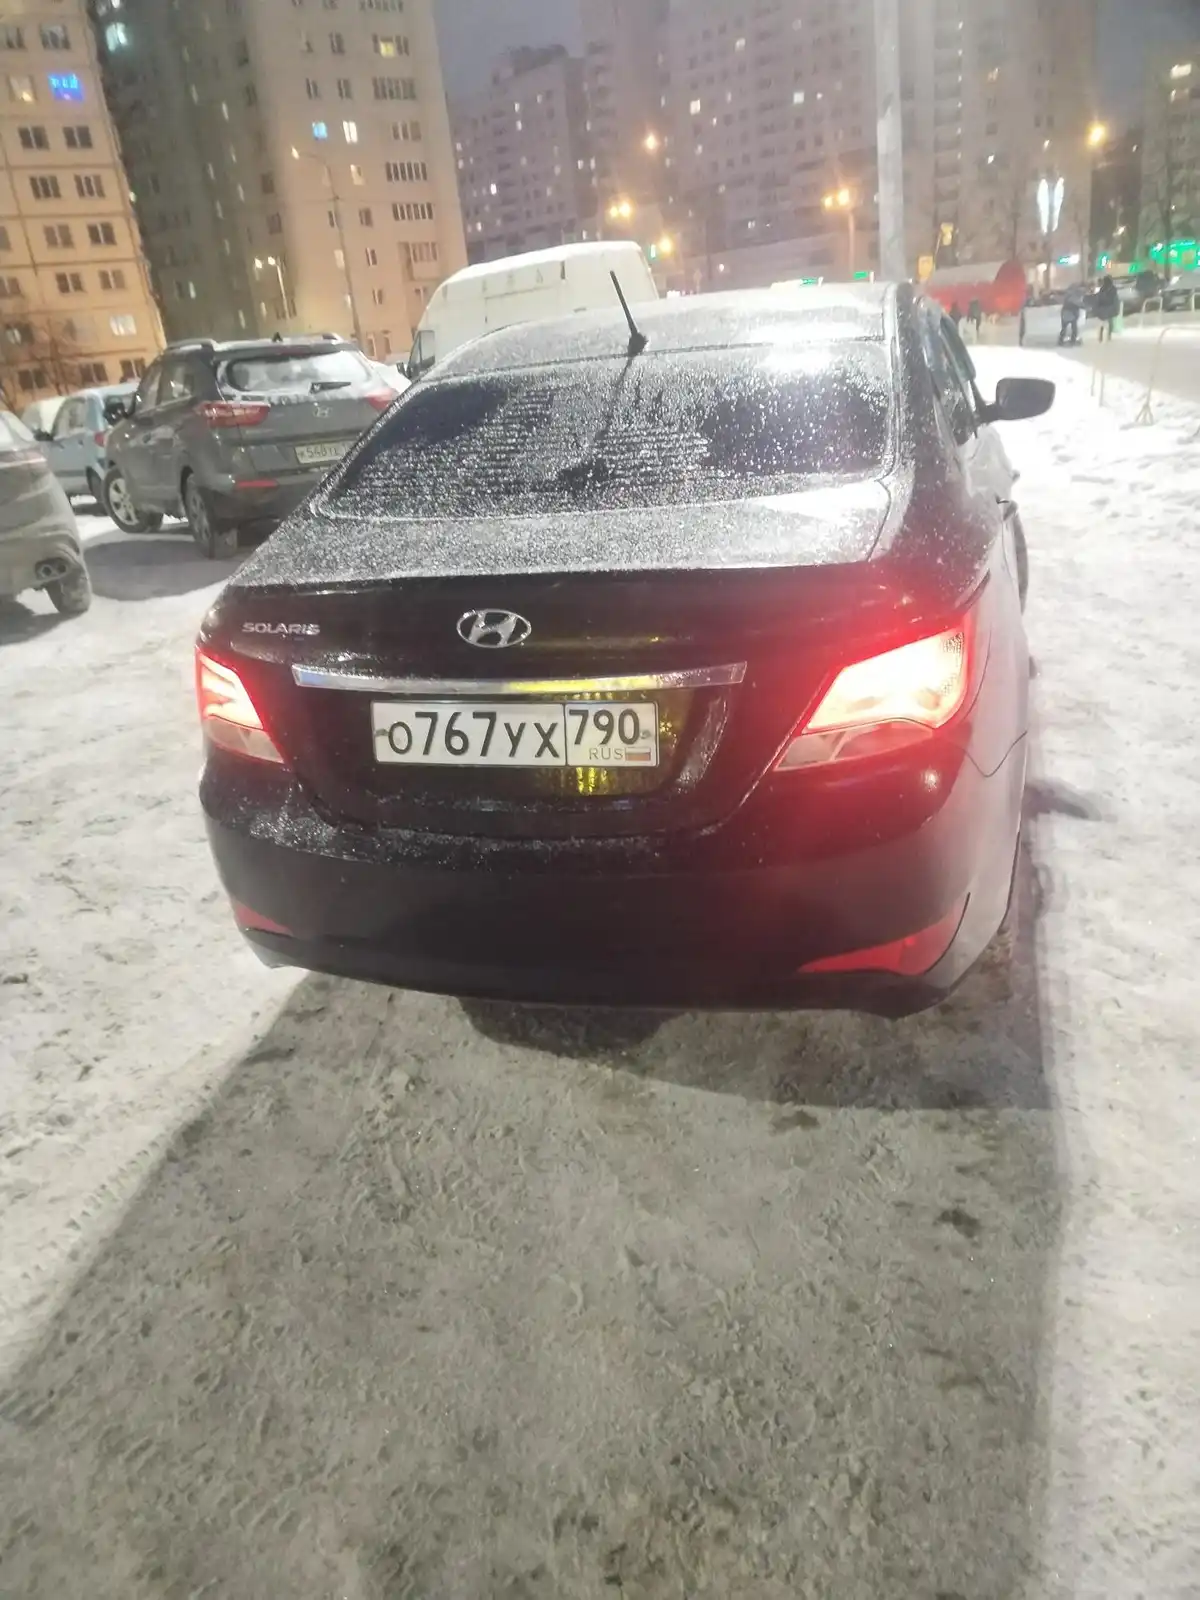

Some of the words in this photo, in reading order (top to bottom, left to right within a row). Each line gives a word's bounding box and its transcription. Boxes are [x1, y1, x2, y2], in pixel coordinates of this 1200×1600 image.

[241, 621, 321, 636] SOLARIS
[569, 708, 640, 746] 790
[589, 747, 624, 761] RUS
